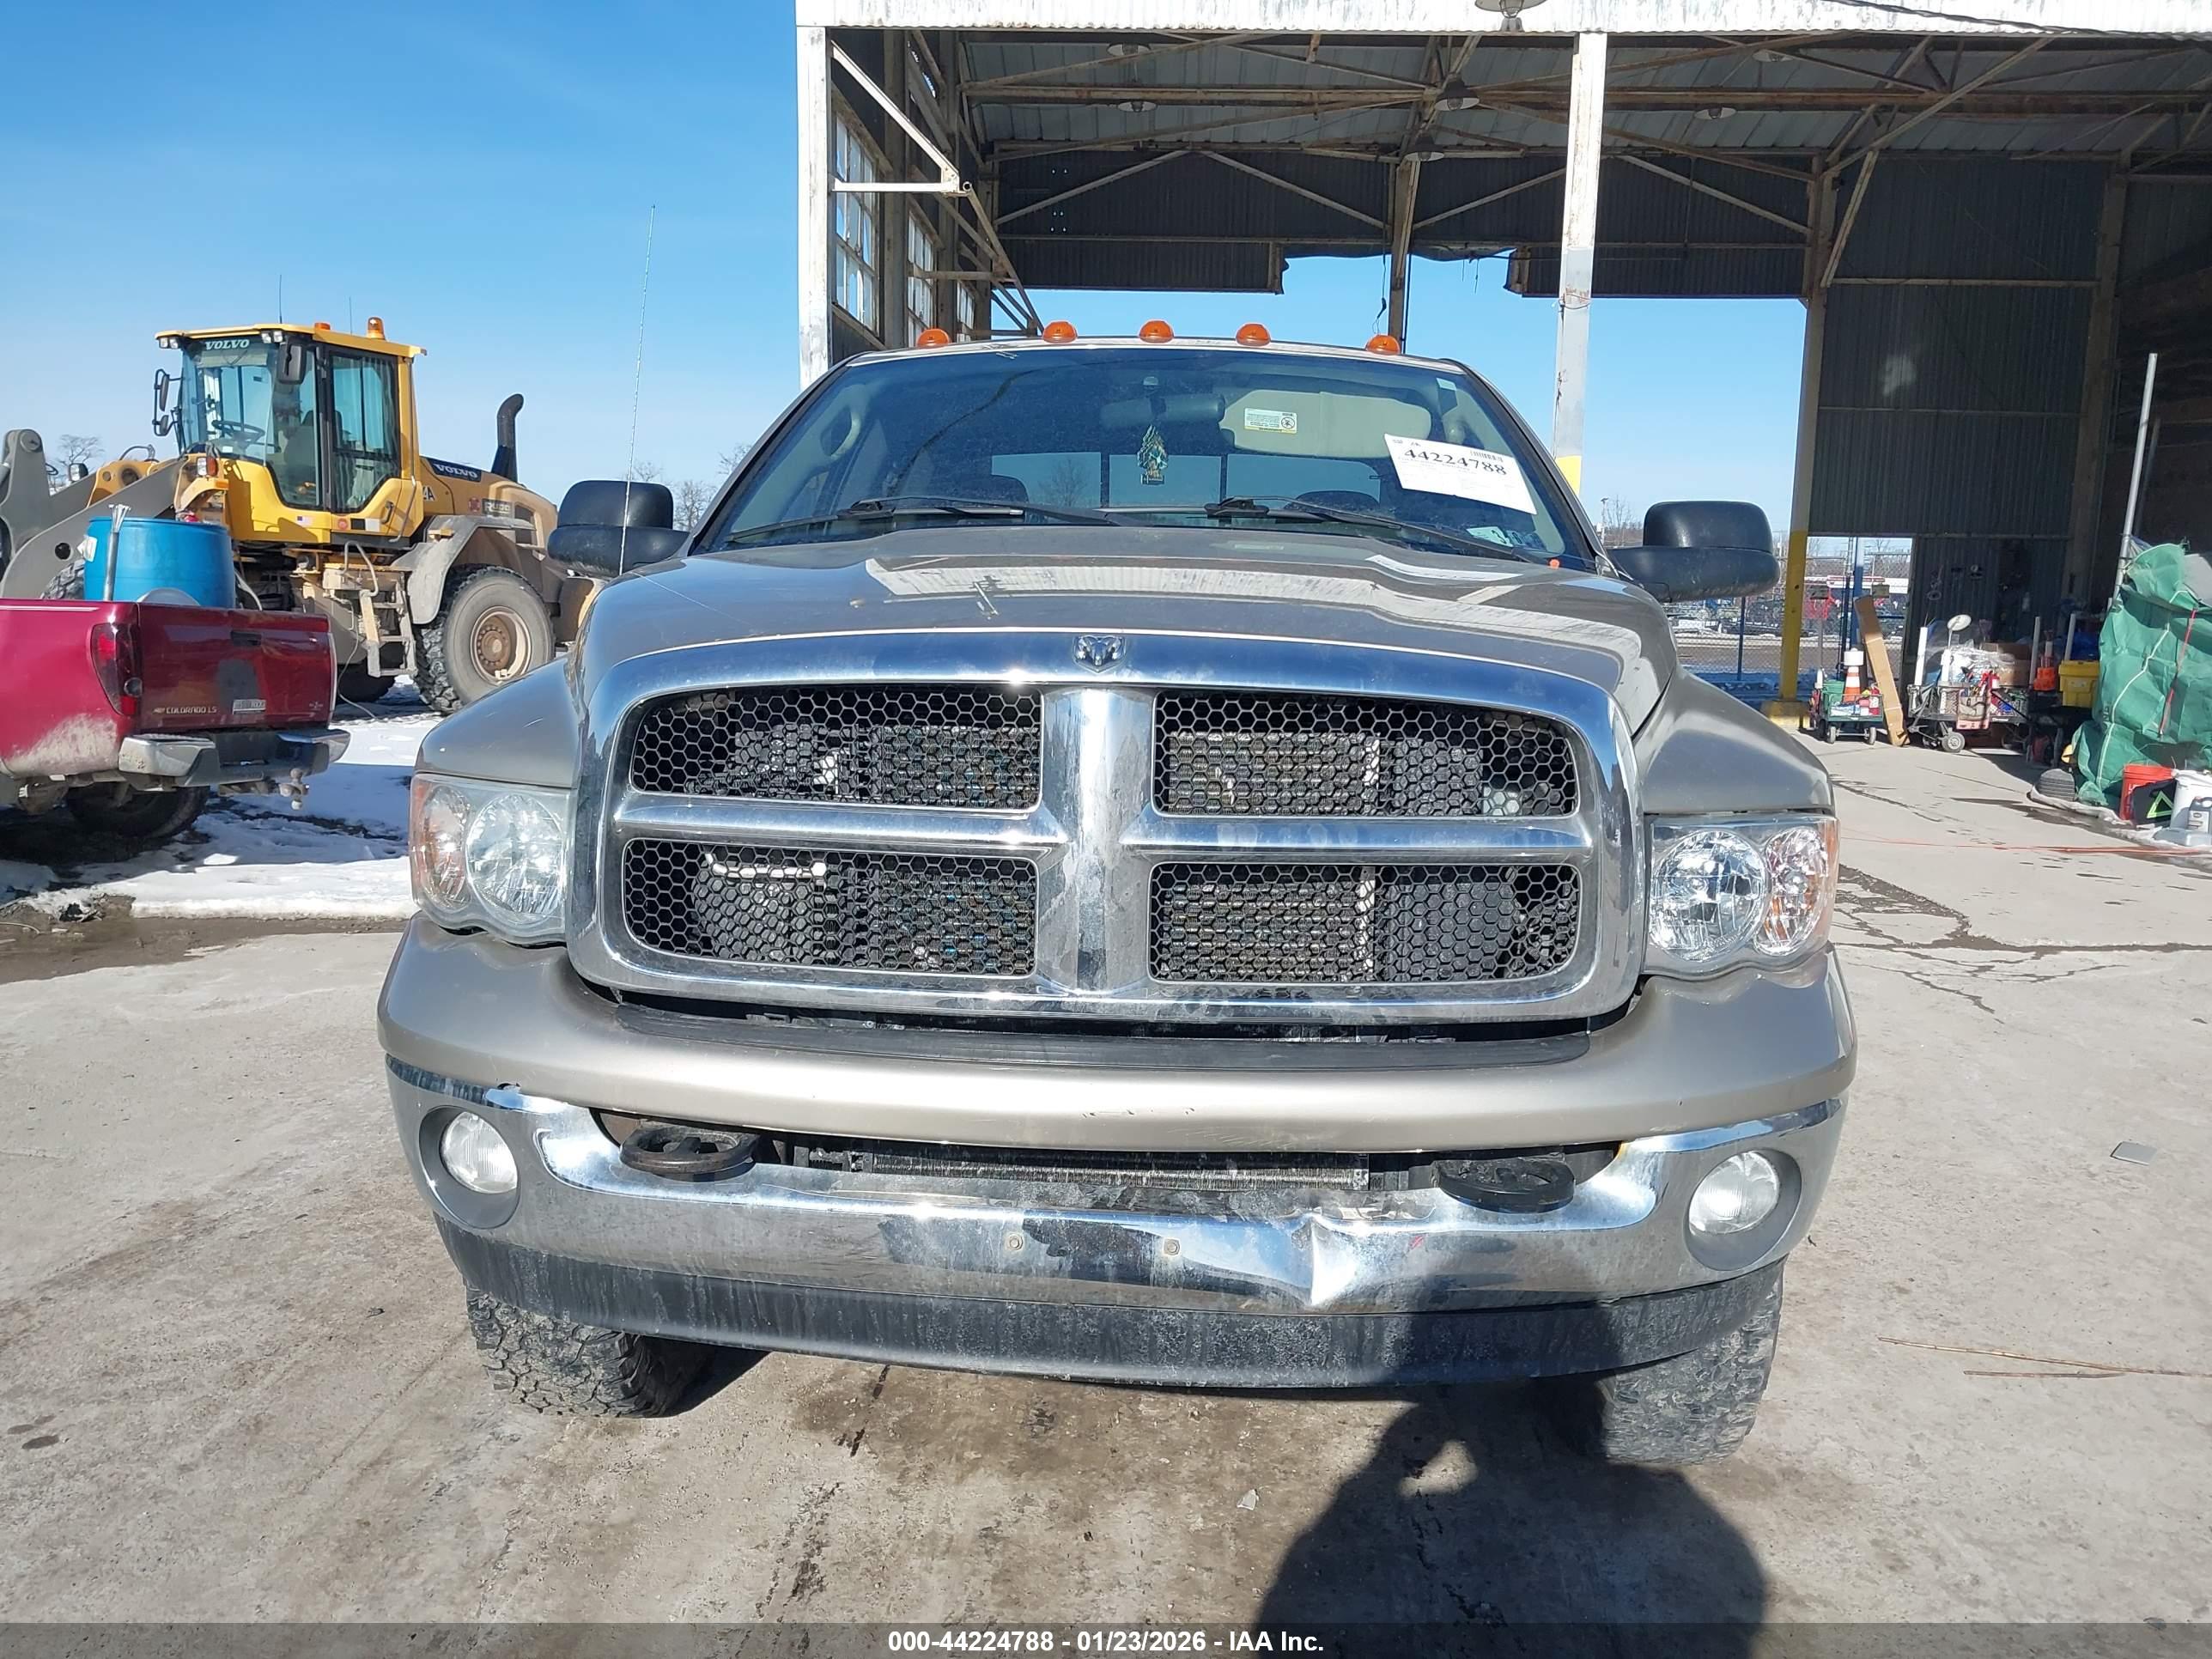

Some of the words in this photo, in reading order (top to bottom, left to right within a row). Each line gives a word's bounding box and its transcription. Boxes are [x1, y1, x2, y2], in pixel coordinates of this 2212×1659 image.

[205, 338, 250, 350] VOLVO
[1405, 449, 1507, 475] 44224788
[433, 463, 478, 478] VOLVO
[166, 706, 206, 714] COLORADO
